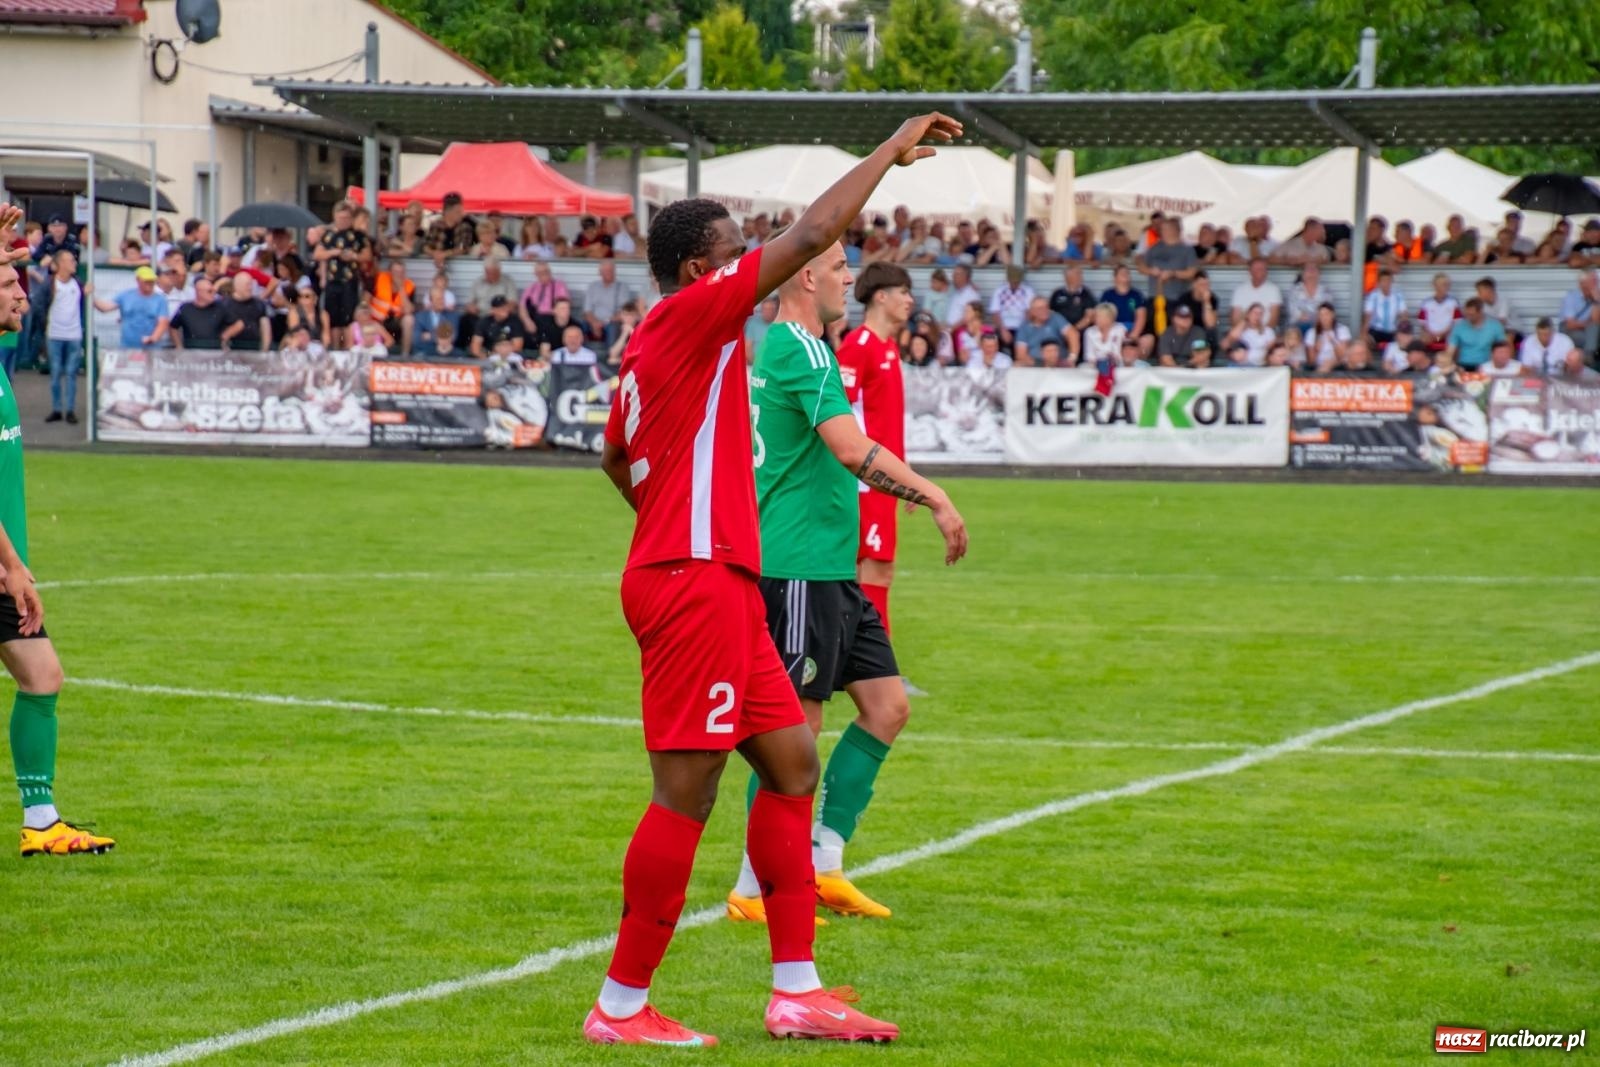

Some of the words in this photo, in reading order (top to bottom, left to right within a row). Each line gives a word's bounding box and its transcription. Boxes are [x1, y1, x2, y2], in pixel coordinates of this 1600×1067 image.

[373, 365, 477, 385] KREWETKA
[1294, 382, 1408, 401] KREWETKA
[1026, 386, 1266, 428] KERAKOLL
[865, 523, 882, 552] 4
[706, 682, 735, 733] 2
